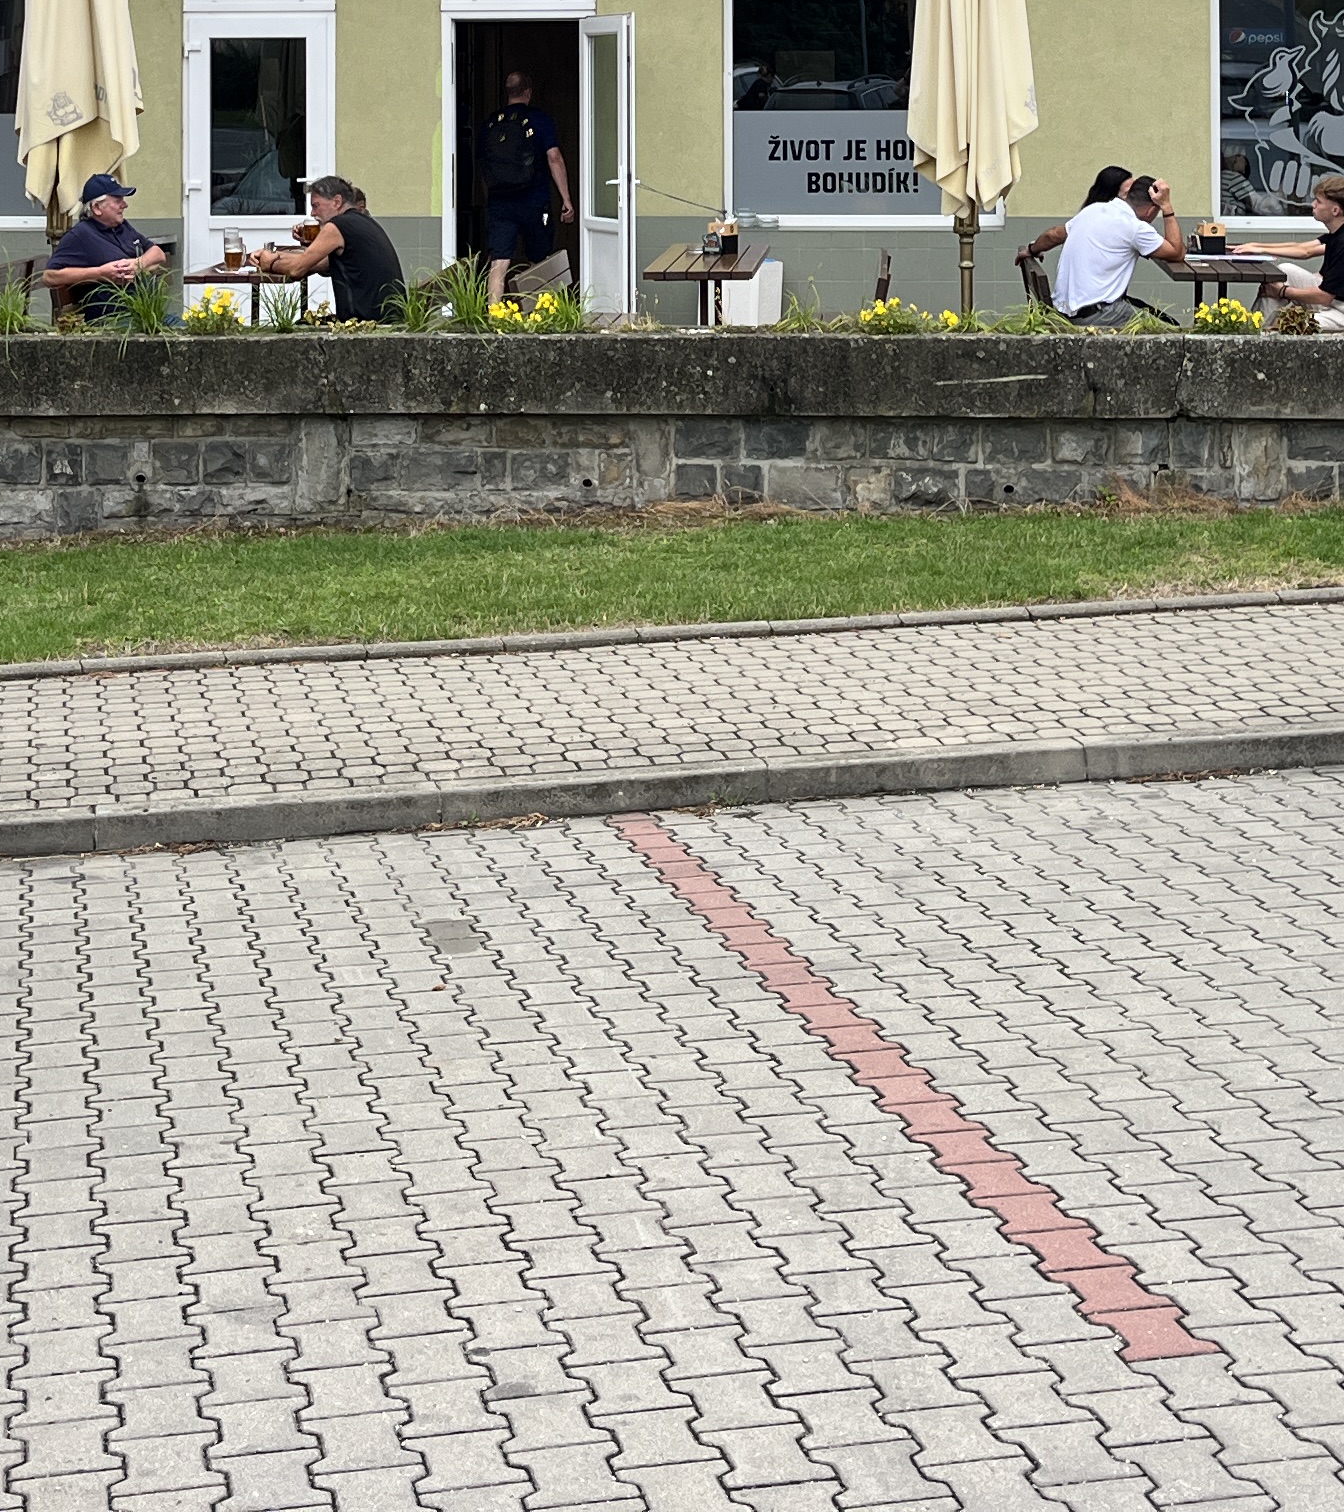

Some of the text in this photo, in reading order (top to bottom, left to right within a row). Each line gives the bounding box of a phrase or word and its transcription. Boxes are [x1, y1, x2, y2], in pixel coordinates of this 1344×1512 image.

[1248, 32, 1284, 45] pepsi
[768, 135, 835, 161] ŽIVOT
[843, 139, 867, 161] JE
[807, 168, 919, 193] BOHUDÍK!
